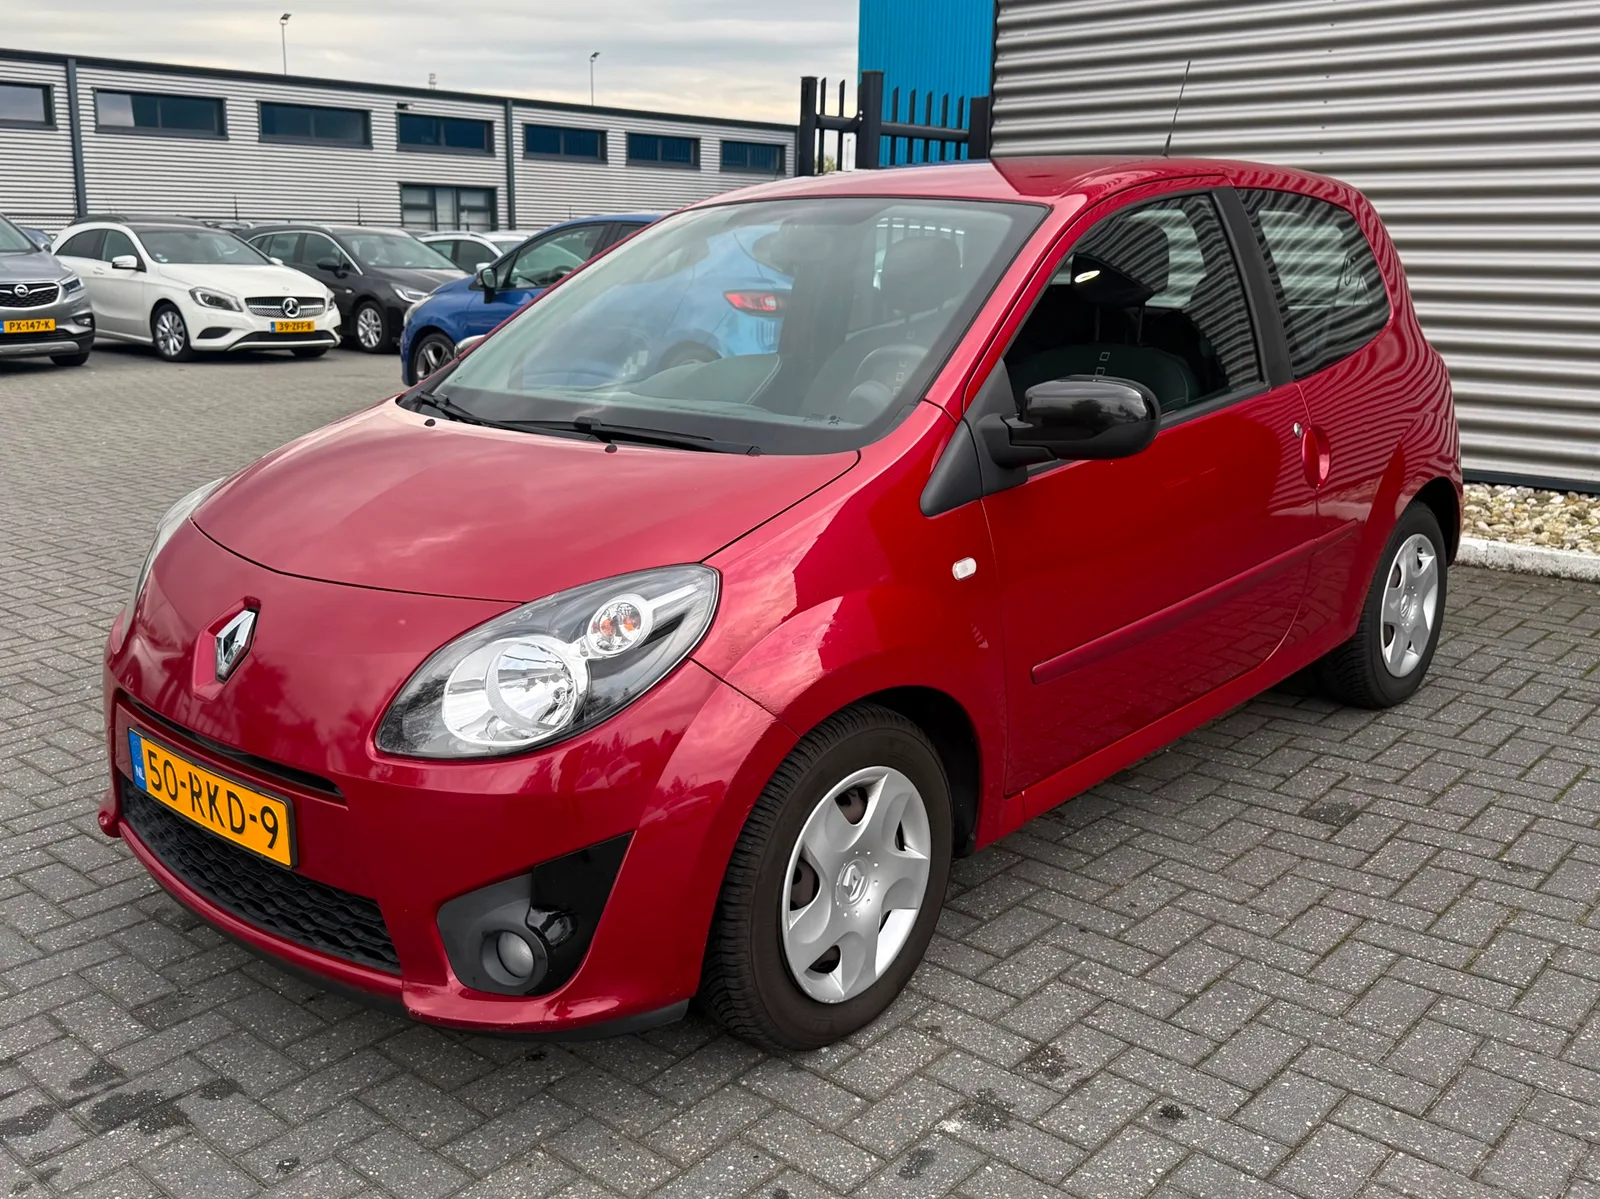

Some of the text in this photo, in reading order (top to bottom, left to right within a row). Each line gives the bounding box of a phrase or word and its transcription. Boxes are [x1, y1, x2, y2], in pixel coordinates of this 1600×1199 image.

[9, 320, 51, 331] PX-147-K
[135, 765, 145, 781] NL
[147, 748, 279, 850] 50-RKD-9
